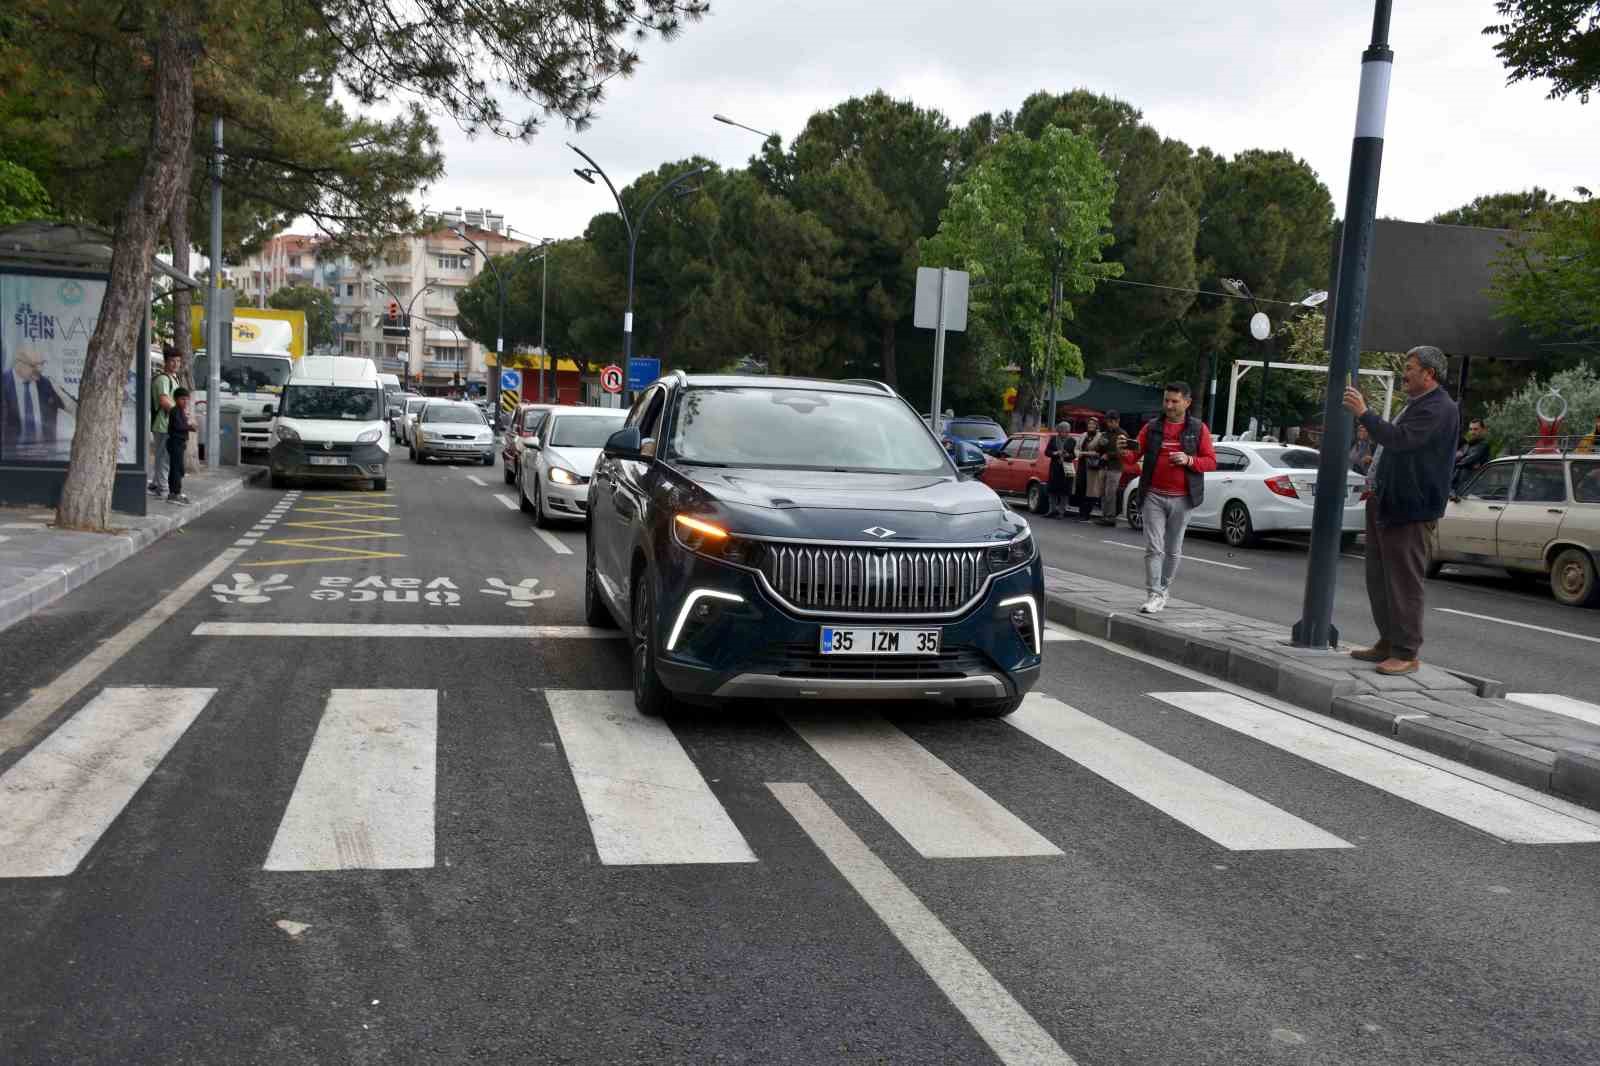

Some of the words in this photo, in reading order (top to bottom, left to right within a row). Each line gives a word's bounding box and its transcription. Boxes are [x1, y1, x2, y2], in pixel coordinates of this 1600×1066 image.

[832, 632, 853, 650] 35
[871, 632, 900, 651] IZM
[917, 633, 937, 651] 35
